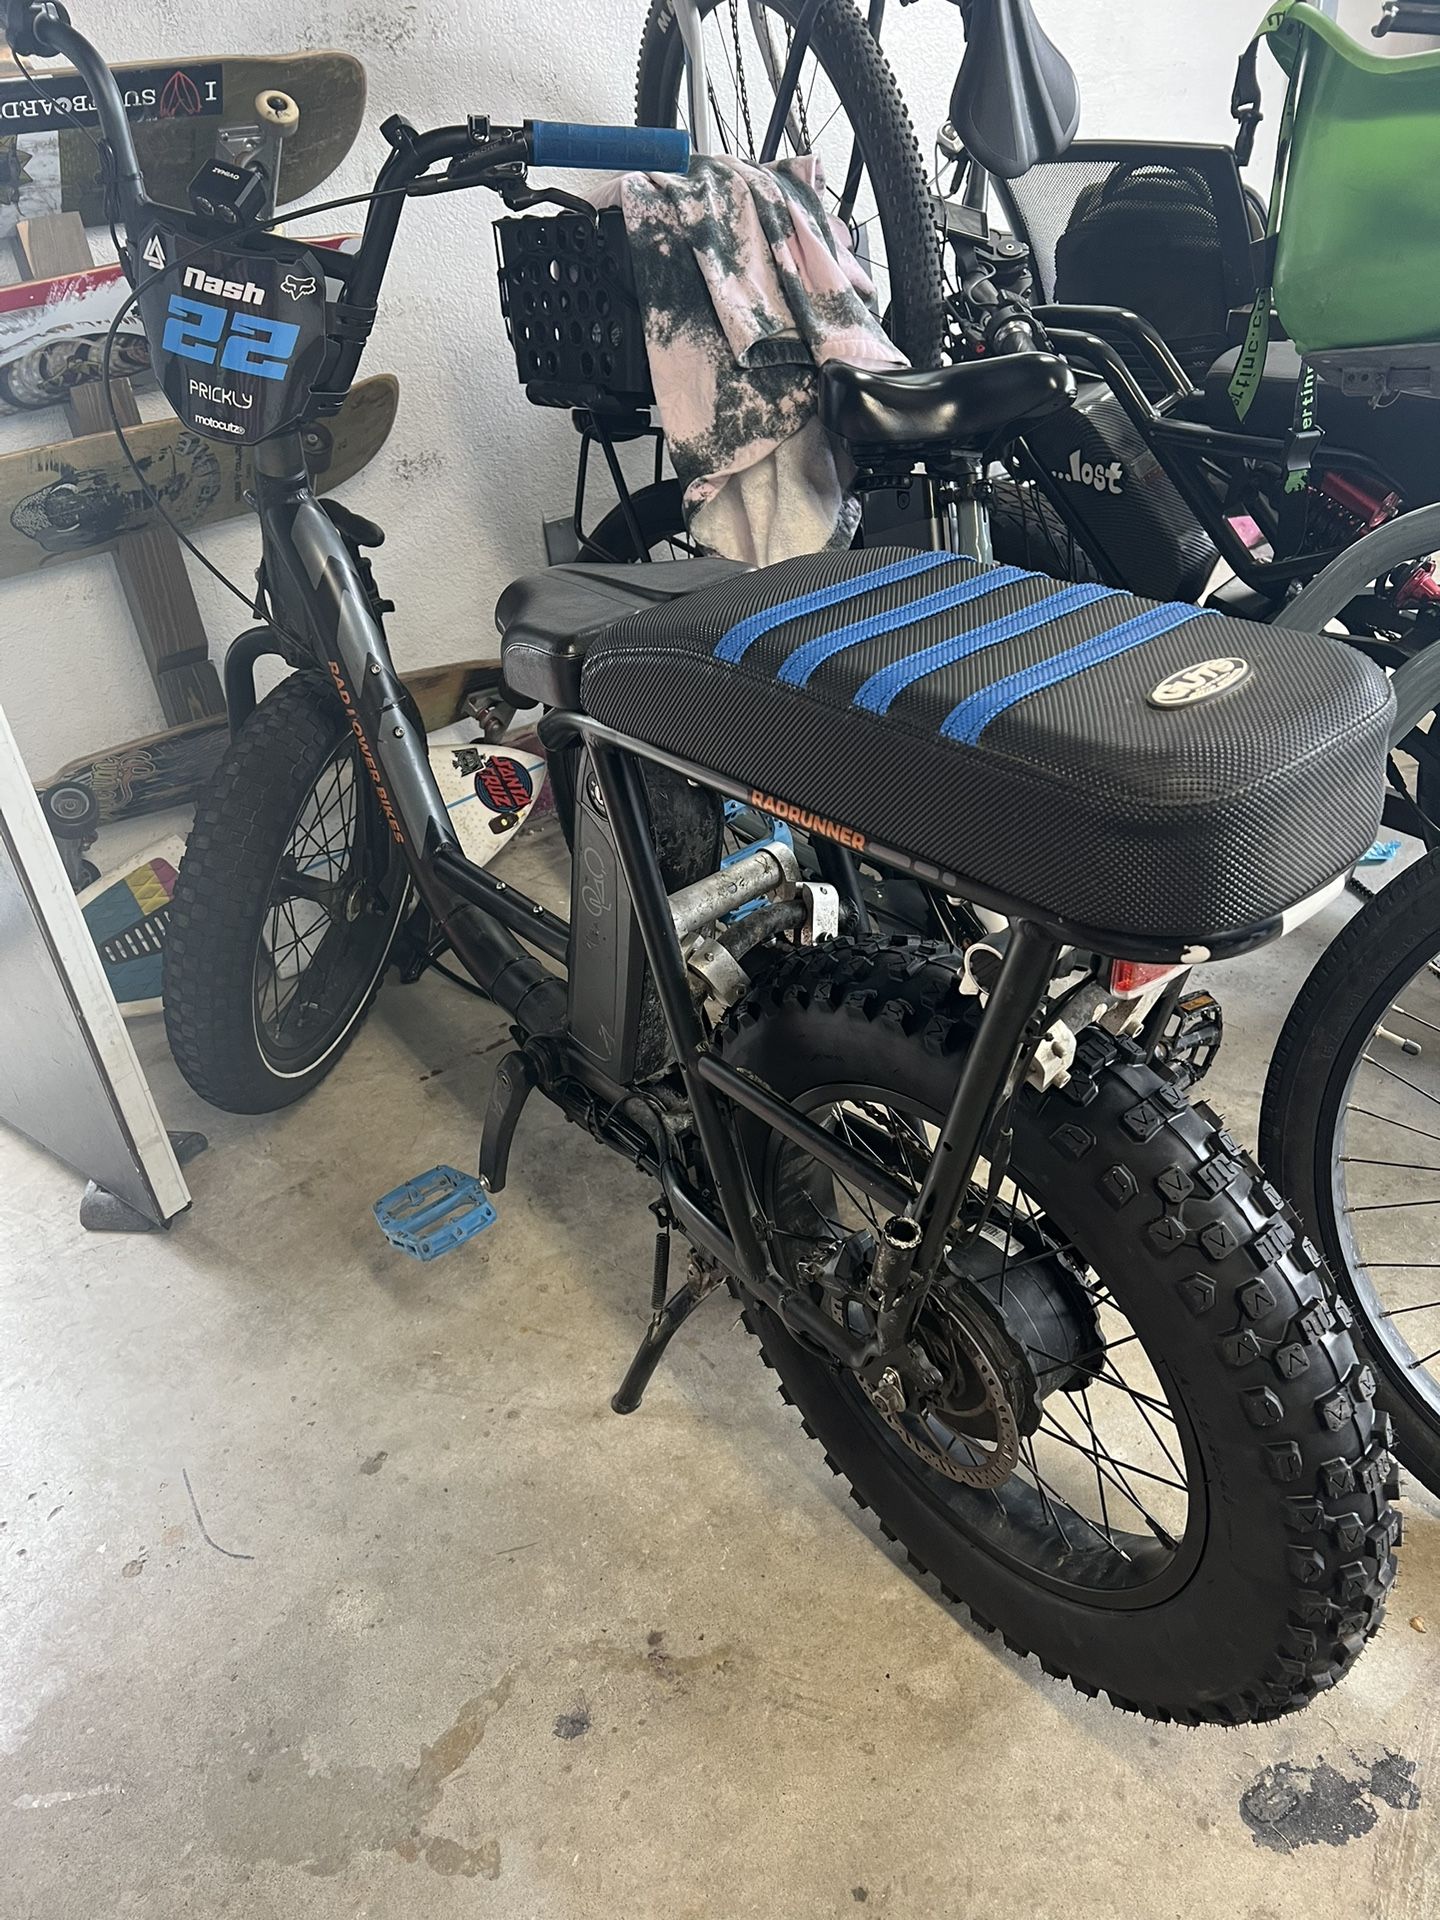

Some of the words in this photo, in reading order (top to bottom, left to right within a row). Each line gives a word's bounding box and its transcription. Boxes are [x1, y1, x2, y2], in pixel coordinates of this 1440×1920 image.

[162, 294, 300, 381] 22
[189, 379, 253, 409] PRICKLY
[1153, 660, 1235, 700] GUTS
[328, 660, 351, 705] RAD
[376, 786, 405, 844] BIKES
[490, 755, 533, 807] SANTA
[751, 789, 865, 852] RADRUNNER
